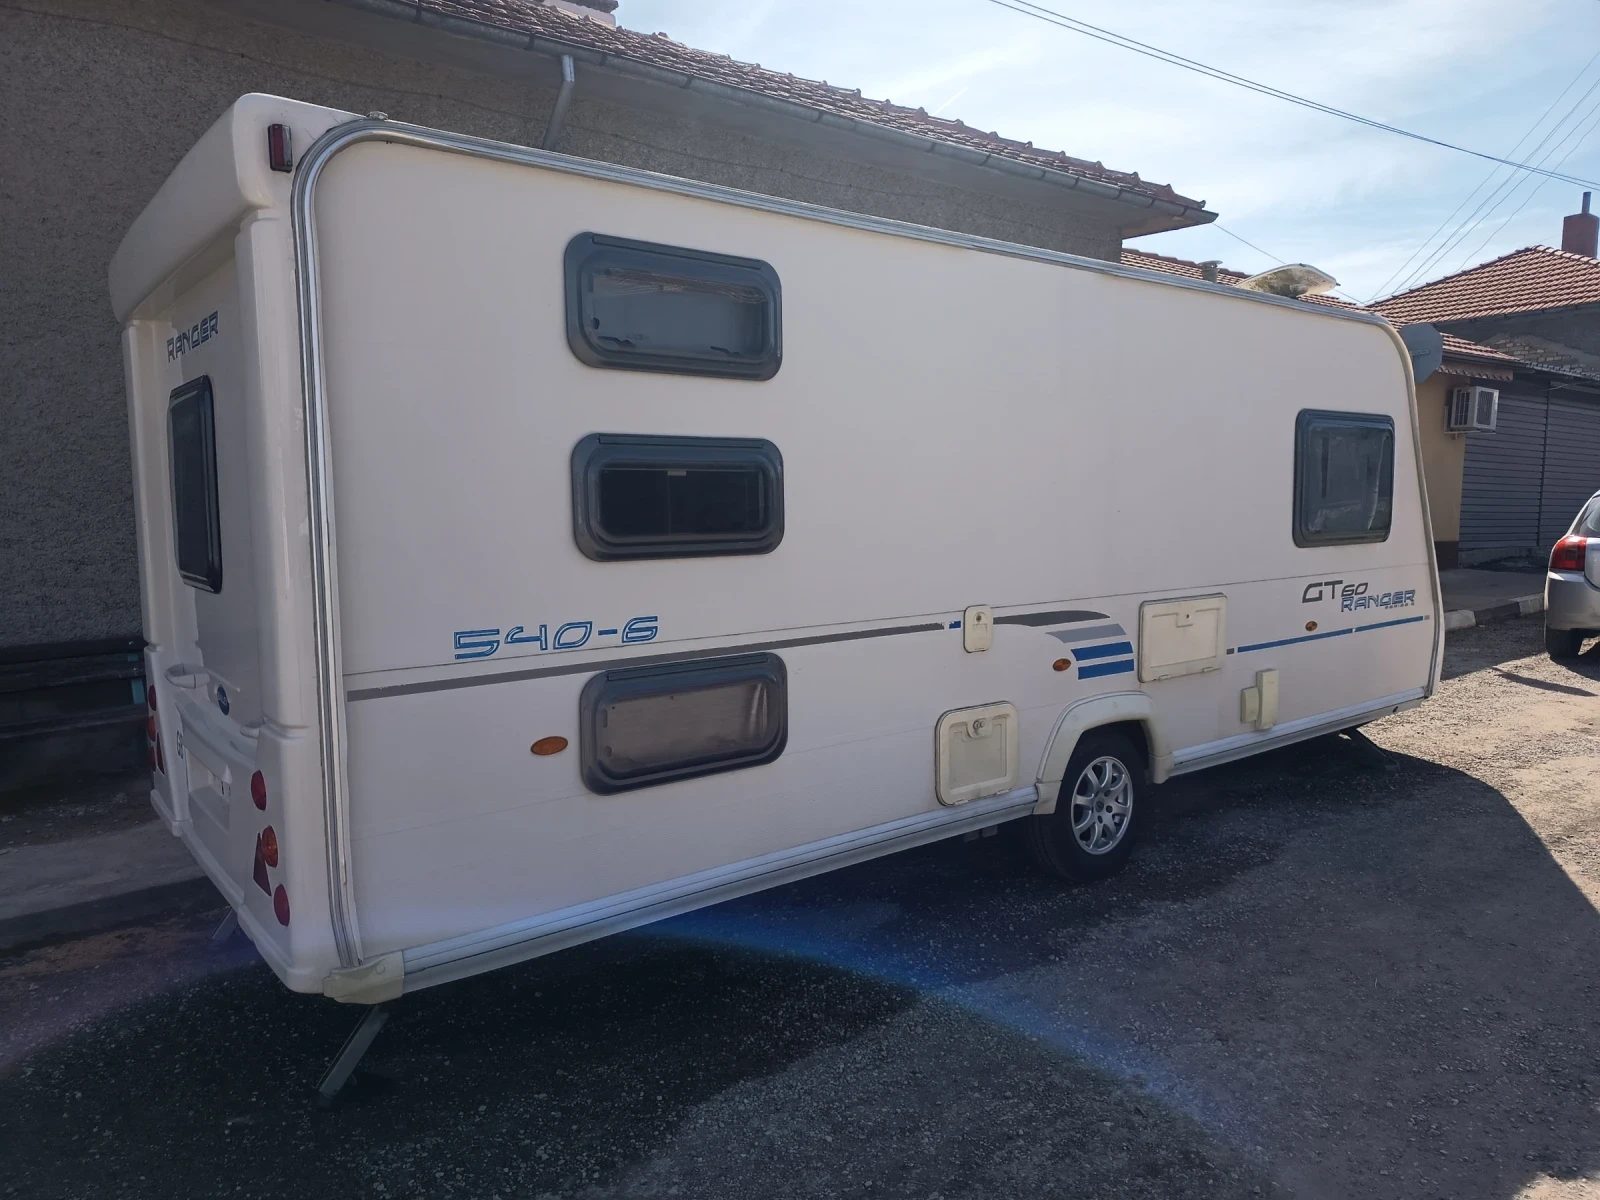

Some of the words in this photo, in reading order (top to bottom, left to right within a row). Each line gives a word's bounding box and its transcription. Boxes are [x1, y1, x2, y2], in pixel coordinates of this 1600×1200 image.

[166, 310, 219, 363] RANGER
[1341, 589, 1416, 612] RANGER
[454, 616, 658, 660] 540-6
